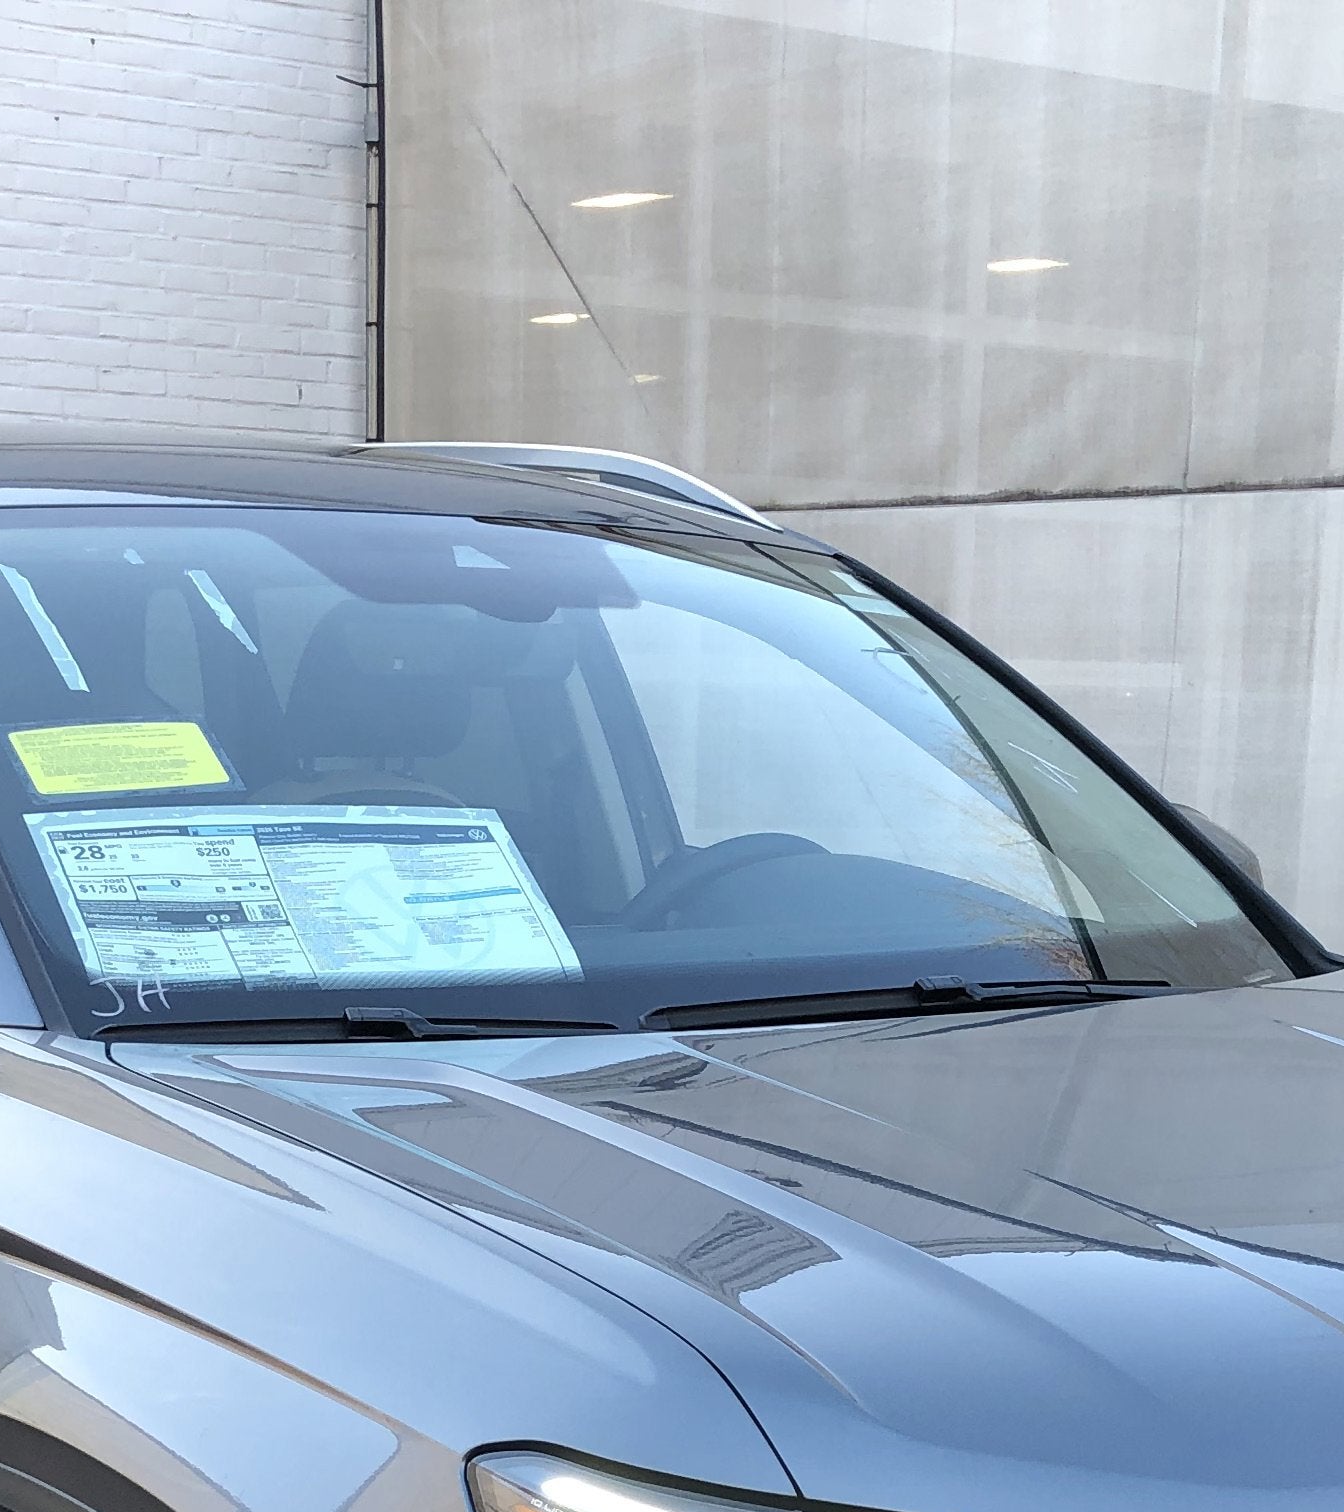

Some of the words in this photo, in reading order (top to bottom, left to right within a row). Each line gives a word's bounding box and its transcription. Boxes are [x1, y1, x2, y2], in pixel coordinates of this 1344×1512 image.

[205, 838, 235, 847] spend
[70, 845, 106, 860] 28
[195, 847, 230, 857] $250
[78, 884, 128, 894] $1,750
